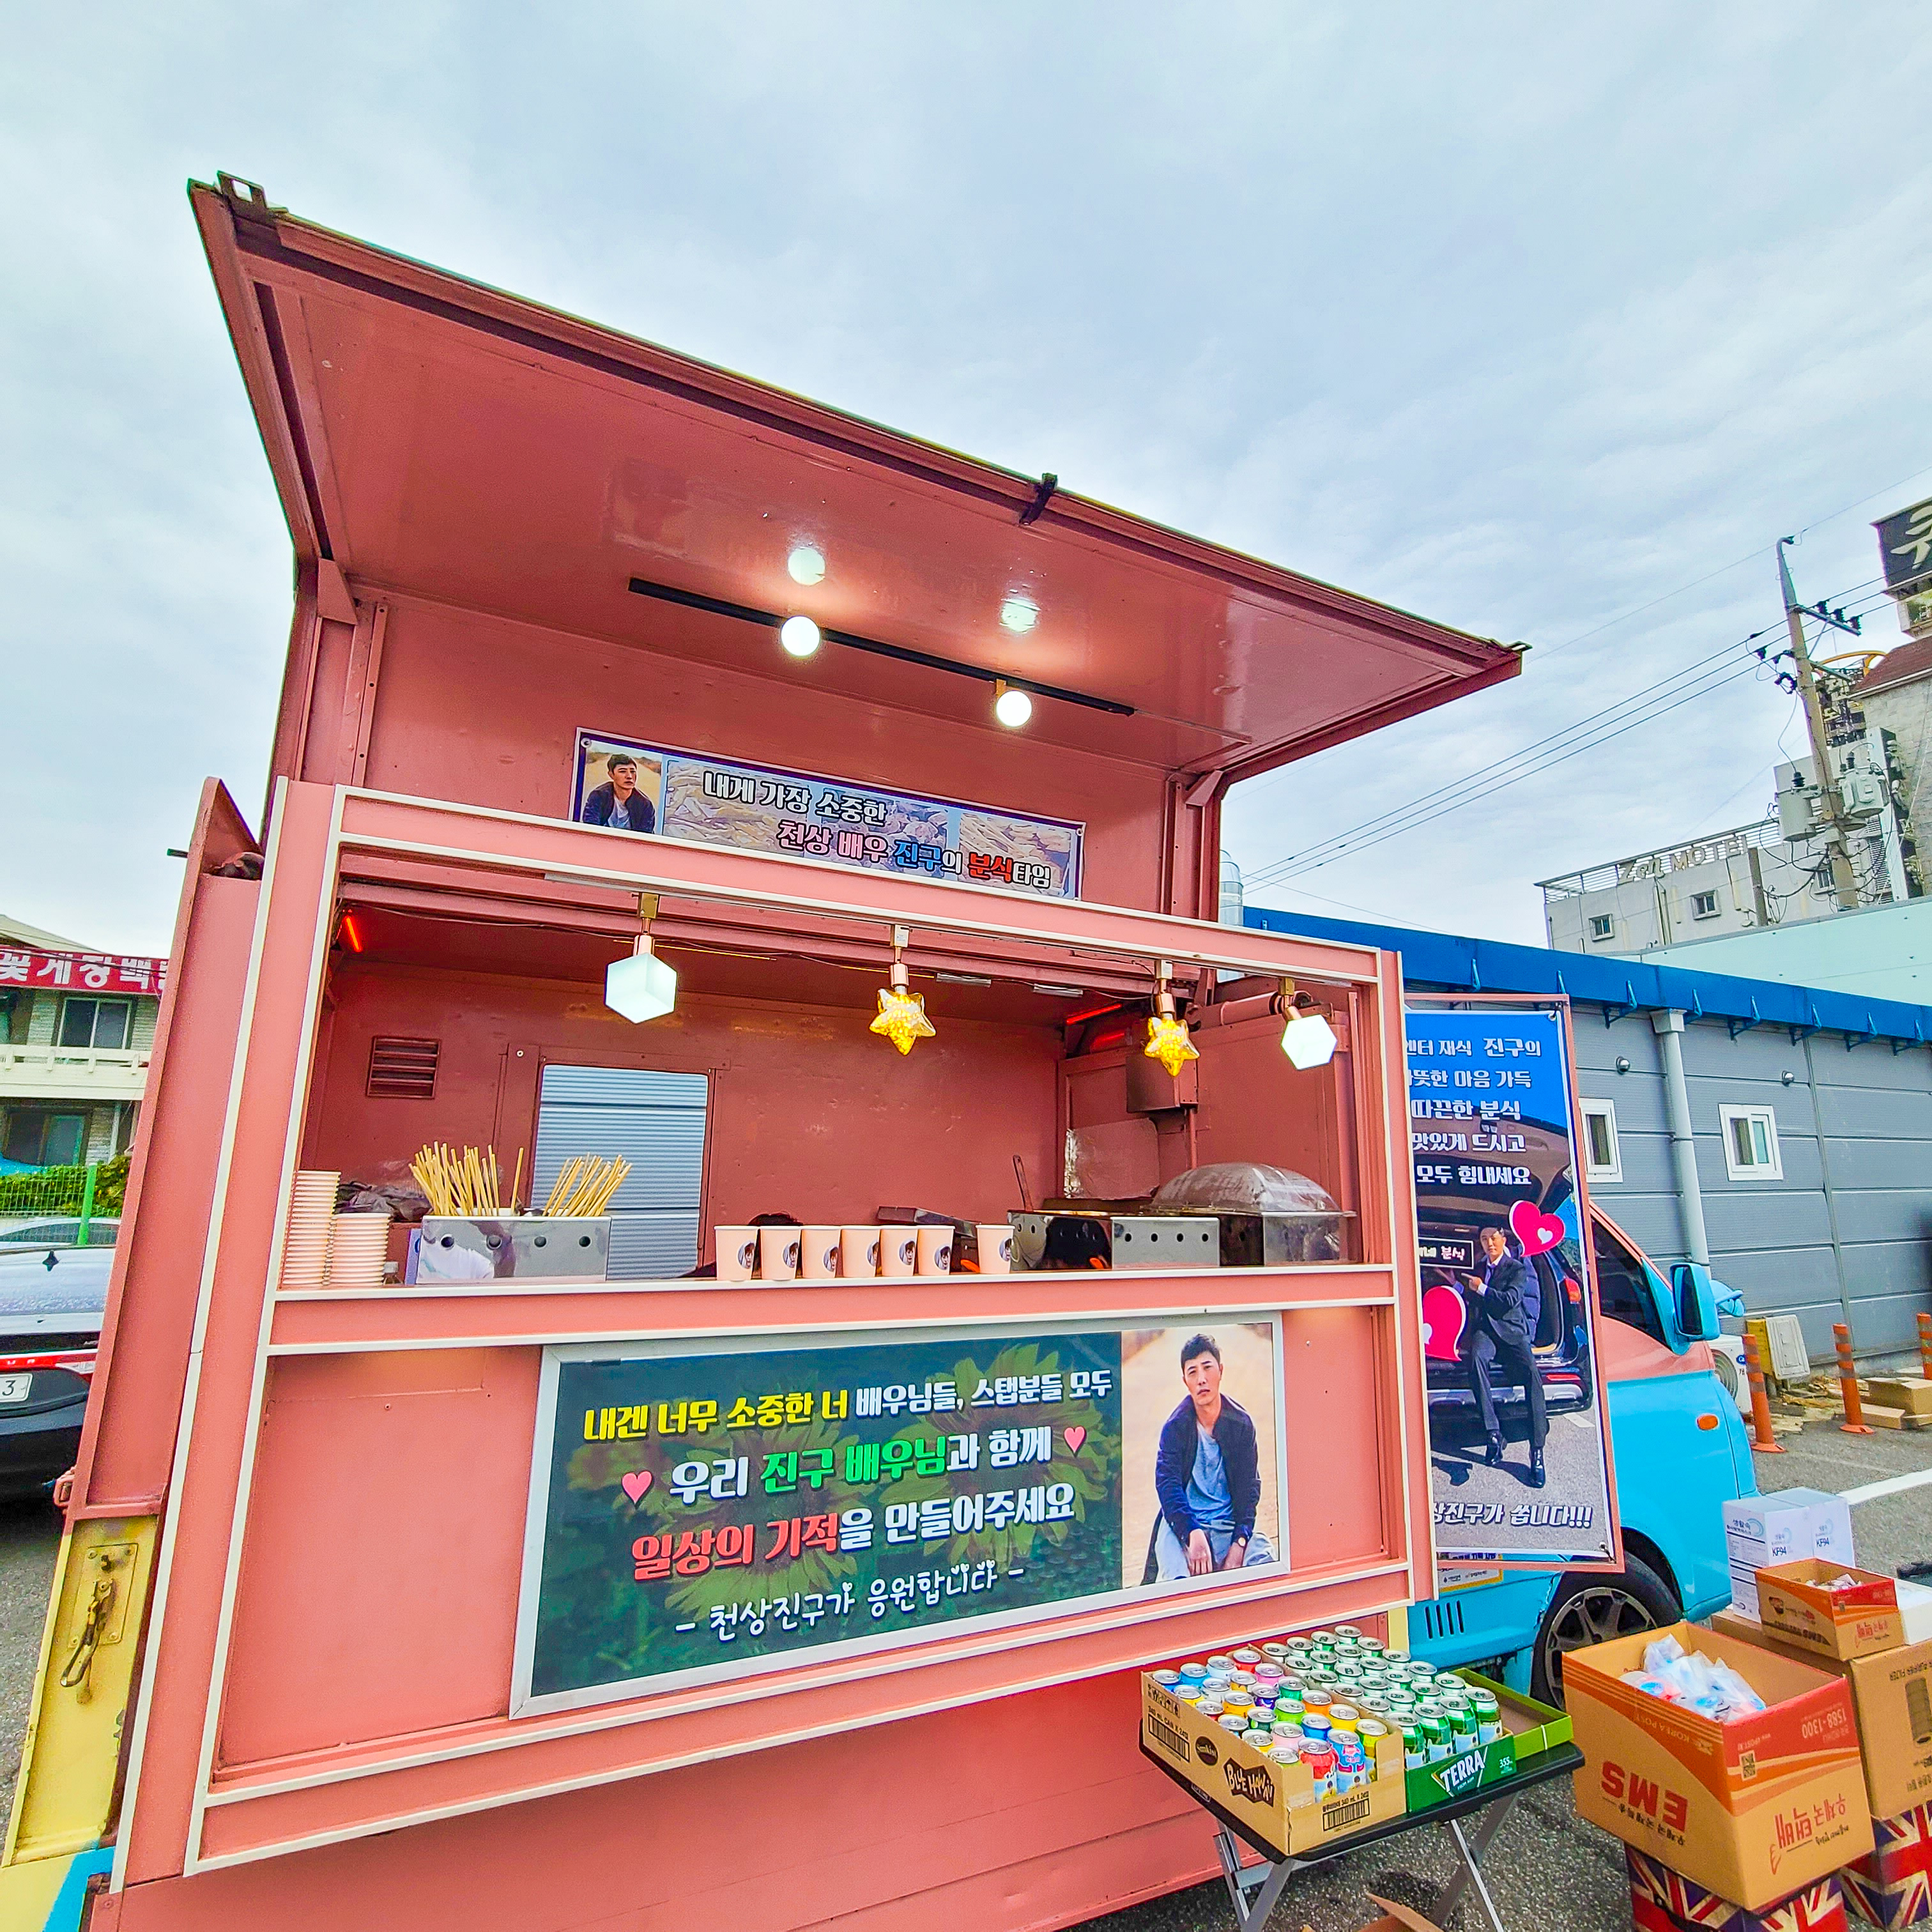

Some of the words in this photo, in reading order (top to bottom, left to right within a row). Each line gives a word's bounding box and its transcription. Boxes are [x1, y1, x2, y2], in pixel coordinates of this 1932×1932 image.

[703, 770, 756, 804] 내게
[760, 781, 811, 815] 가장
[814, 790, 887, 827] 소중한
[777, 820, 832, 856] 천상
[836, 828, 889, 864] 배우
[893, 838, 962, 876] 진구의
[967, 852, 1052, 889] 분식타임
[1438, 1039, 1472, 1056] 재식
[1483, 1038, 1541, 1057] 진구의
[1454, 1070, 1491, 1088] 마음
[1496, 1070, 1531, 1088] 가득
[1411, 1099, 1473, 1120] 따끈한
[1480, 1100, 1521, 1121] 분식
[1412, 1133, 1467, 1151] 맛있게
[1472, 1133, 1526, 1152] 드시고
[1416, 1165, 1453, 1183] 모두
[1458, 1165, 1532, 1185] 힘내세요
[584, 1405, 648, 1441] 내겐
[657, 1400, 717, 1435] 너무
[726, 1392, 815, 1430] 소중한
[821, 1390, 848, 1420] 너
[855, 1380, 964, 1417] 배우님들,
[970, 1373, 1064, 1407] 스탭분들
[1069, 1369, 1113, 1399] 모두
[670, 1457, 749, 1505] 우리
[760, 1448, 834, 1494] 진구
[845, 1433, 980, 1483] 배우님과
[988, 1425, 1052, 1468] 함께
[632, 1524, 755, 1581] 일상의
[765, 1508, 875, 1560] 기적을
[885, 1482, 1075, 1545] 만들어주세요
[1772, 1546, 1787, 1557] KF94
[1816, 1537, 1830, 1547] KF94
[710, 1582, 855, 1641] 천상진구가
[868, 1560, 998, 1618] 응원합니다
[1440, 1749, 1485, 1793] TERRA
[1601, 1760, 1689, 1833] EMS
